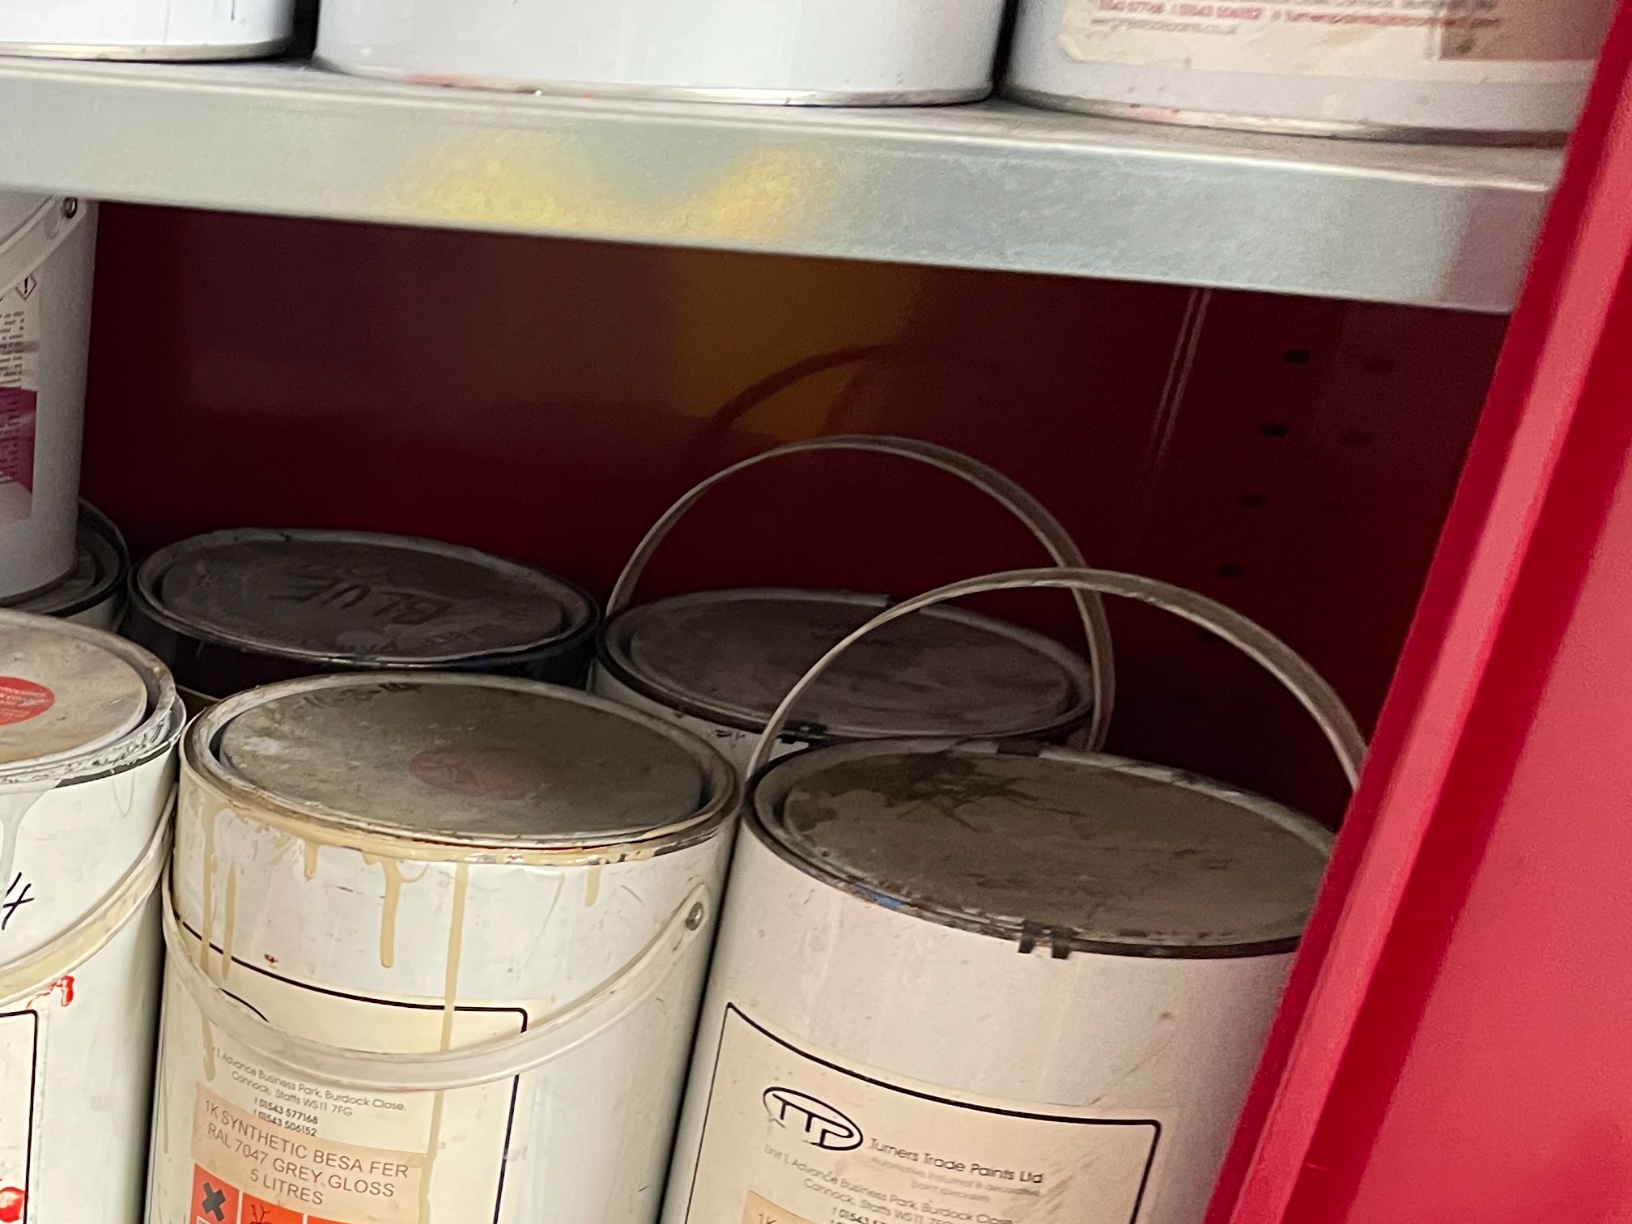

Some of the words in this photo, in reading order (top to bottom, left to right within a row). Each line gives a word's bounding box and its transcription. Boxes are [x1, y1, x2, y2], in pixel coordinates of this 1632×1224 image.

[258, 1066, 296, 1091] Business
[325, 1090, 369, 1106] Burdock
[372, 1098, 406, 1111] Close.
[276, 1089, 301, 1105] Staffs
[303, 1099, 327, 1111] WS11
[331, 1104, 353, 1117] 7FG
[258, 1111, 283, 1127] 01543
[284, 1121, 317, 1137] 506152
[260, 1098, 284, 1114] 01543
[286, 1108, 318, 1125] 577168
[768, 1090, 859, 1150] TTP
[205, 1100, 218, 1118] 1K
[220, 1110, 307, 1159] SYNTHETIC
[313, 1149, 363, 1172] BESA
[370, 1161, 409, 1178] FER
[208, 1123, 231, 1149] RAL
[236, 1139, 268, 1165] 7047
[273, 1158, 322, 1183] GREY
[328, 1175, 395, 1197] GLOSS
[869, 1138, 919, 1162] Turners
[924, 1153, 965, 1172] Trade
[971, 1163, 1014, 1181] Paints
[1020, 1170, 1044, 1184] Ltd
[250, 1169, 259, 1182] 5
[263, 1174, 324, 1205] LITRES
